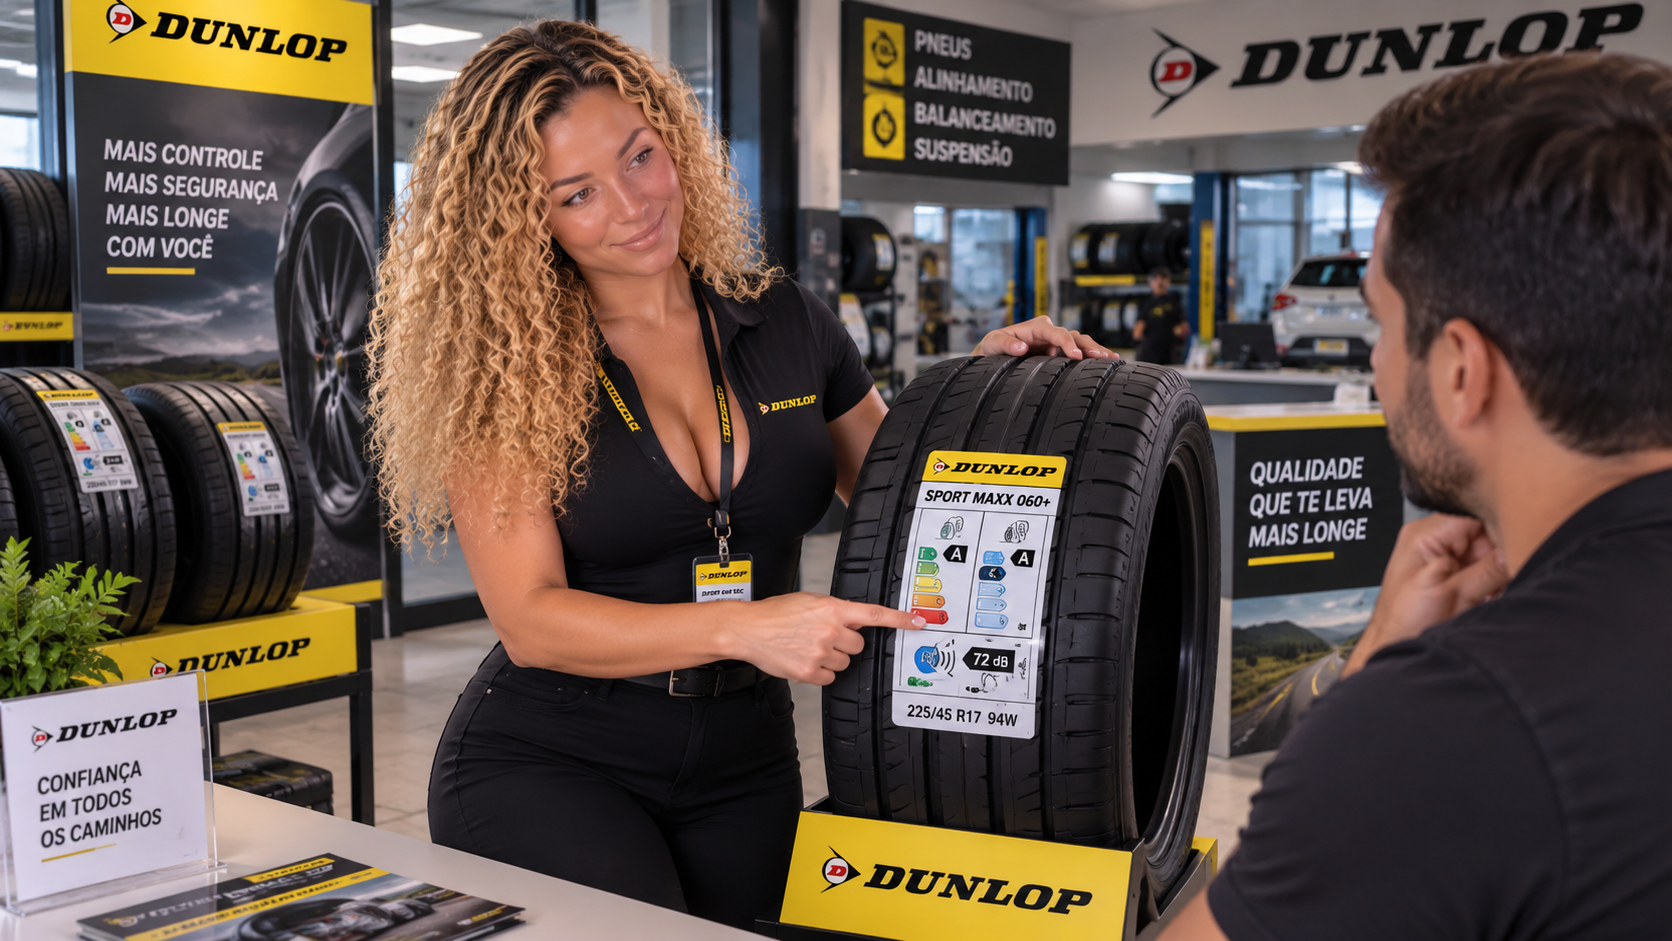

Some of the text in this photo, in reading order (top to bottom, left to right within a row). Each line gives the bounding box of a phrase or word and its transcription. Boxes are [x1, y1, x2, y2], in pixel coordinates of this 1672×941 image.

[150, 11, 347, 62] DUNLOP
[914, 30, 972, 60] PNEUS
[1229, 3, 1644, 89] DUNLOP
[914, 66, 1034, 102] ALINHAMENTO
[914, 102, 1056, 139] BALANCEAMENTO
[104, 139, 264, 170] MAIS CONTROLE
[914, 137, 1012, 167] SUSPENSÃO
[104, 171, 278, 205] MAIS SEGURANÇA
[105, 204, 229, 229] MAIS LONGE
[106, 234, 213, 259] COM VOCÊ
[770, 394, 817, 412] DUNLOP
[951, 462, 1057, 477] DUNLOP
[1250, 456, 1364, 487] QUALIDADE
[925, 489, 1051, 507] SPORT MAXX 060+
[1249, 487, 1373, 519] QUE TE LEVA
[1248, 517, 1368, 548] MAIS LONGE
[950, 547, 962, 561] A
[1018, 551, 1029, 565] A
[708, 571, 747, 579] DUNLOP
[177, 637, 311, 673] DUNLOP
[973, 653, 1008, 668] 72 dB
[56, 708, 178, 744] DUNLOP
[907, 704, 1018, 727] 225/45 R17 94W
[37, 760, 142, 795] CONFIANÇA
[39, 788, 132, 823] EM TODOS
[40, 808, 162, 849] OS CAMINHOS
[863, 863, 1093, 915] DUNLOP
